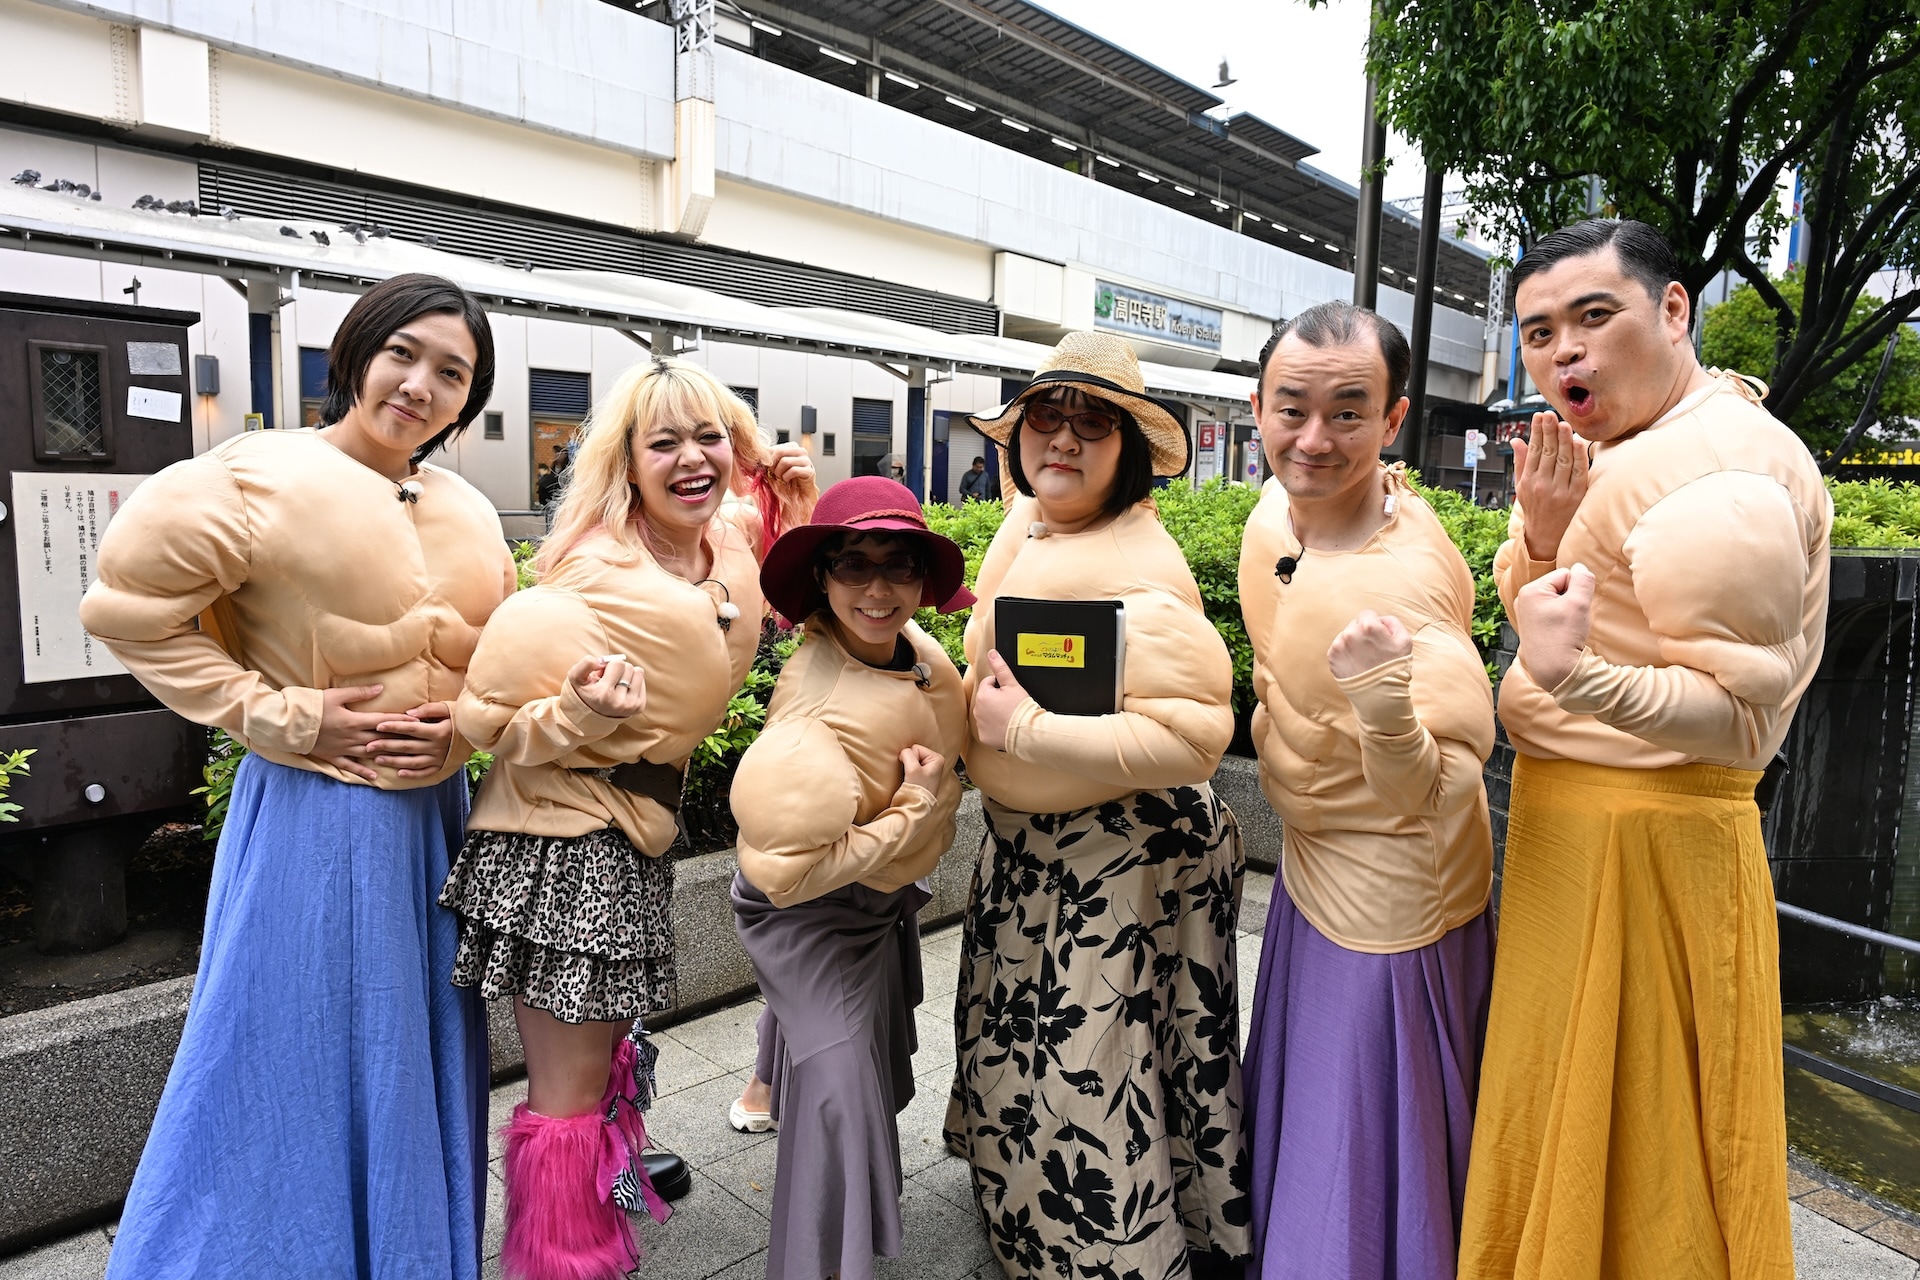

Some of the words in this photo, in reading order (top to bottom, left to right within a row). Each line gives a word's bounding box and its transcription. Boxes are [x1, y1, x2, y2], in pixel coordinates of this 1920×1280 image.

[1115, 296, 1167, 329] 高円寺駅
[1170, 318, 1195, 340] Koenji
[1195, 325, 1221, 343] Station
[1203, 431, 1212, 444] 5
[64, 485, 73, 512] りません。
[87, 490, 98, 553] 鳩は自然の生き物です。
